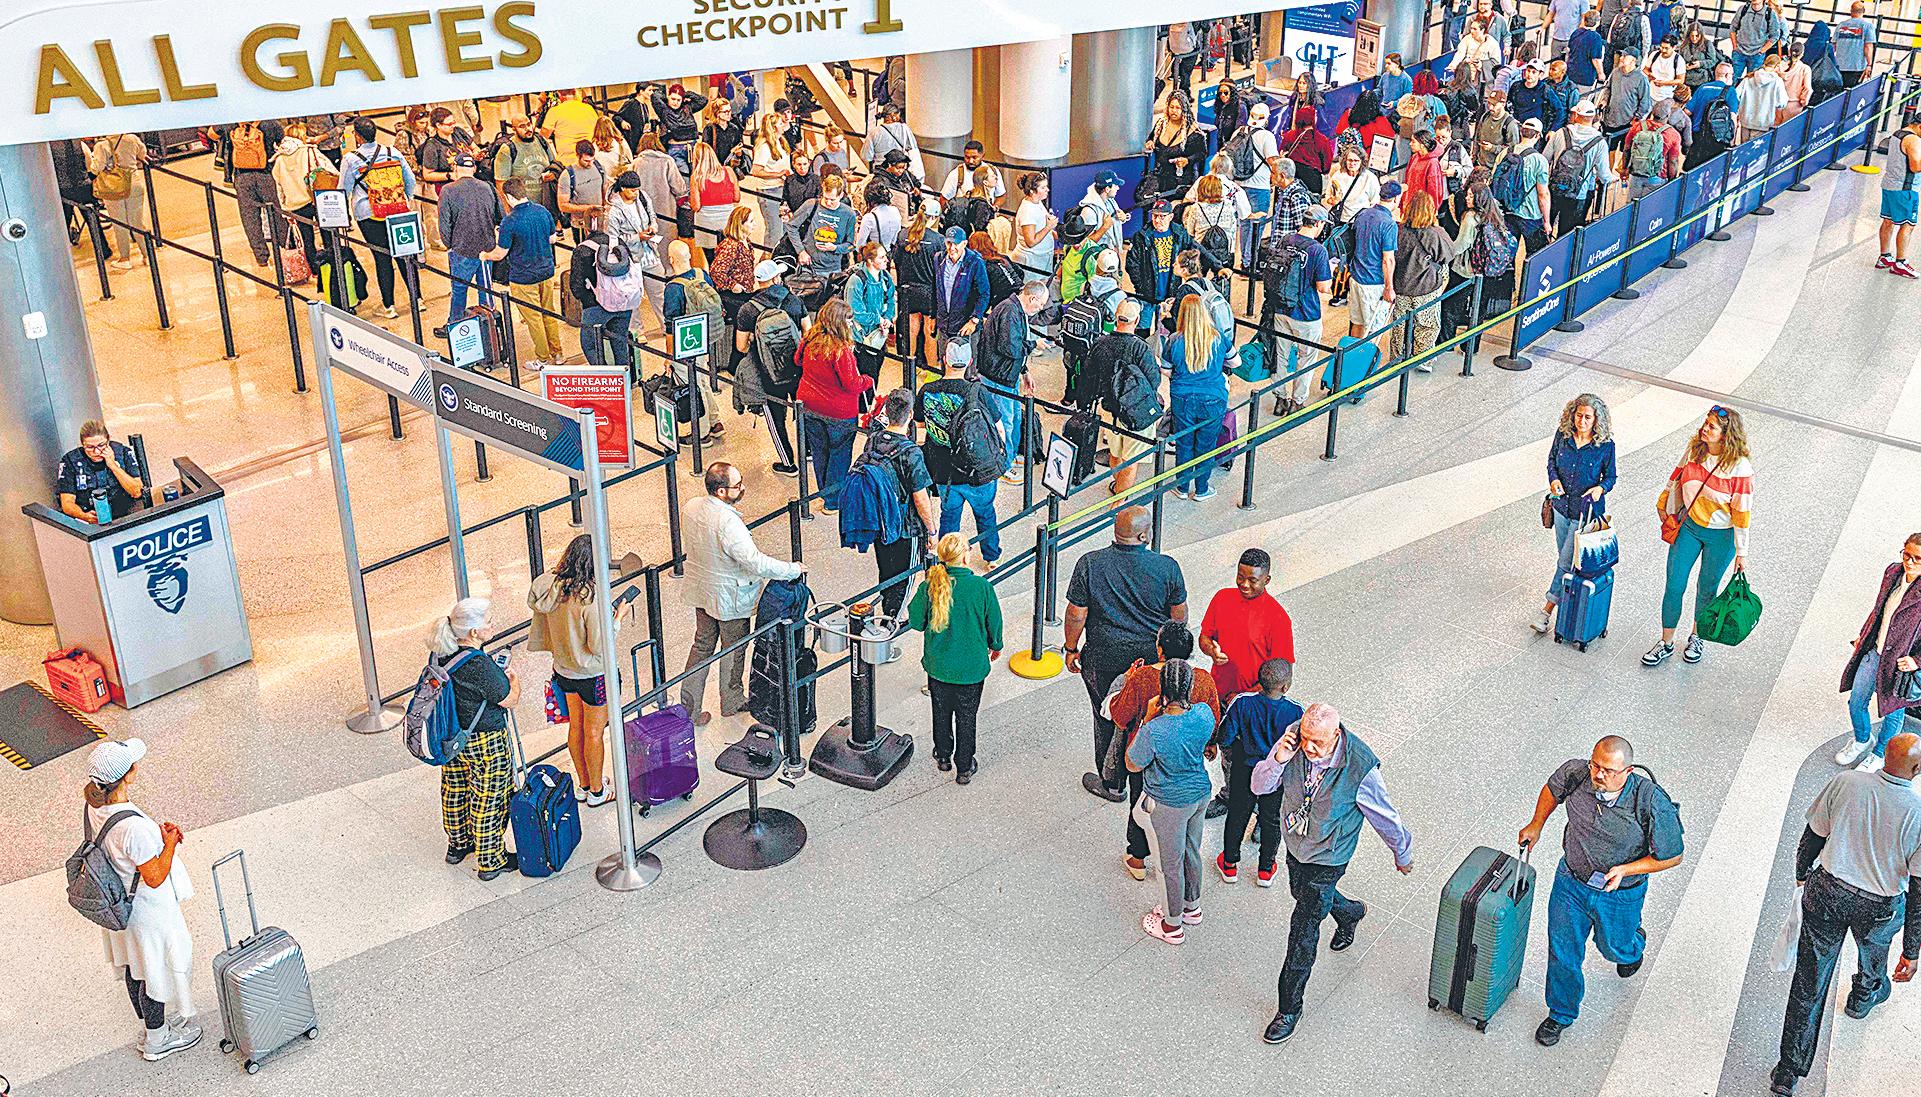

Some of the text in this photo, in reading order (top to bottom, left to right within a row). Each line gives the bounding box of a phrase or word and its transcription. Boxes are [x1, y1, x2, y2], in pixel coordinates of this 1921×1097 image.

[637, 7, 848, 48] CHECKPOINT
[34, 1, 543, 115] ALL GATES
[1586, 238, 1621, 268] AI-Powered
[1521, 295, 1561, 329] SentinelOne
[348, 338, 410, 377] Wheelchair Access
[552, 377, 624, 387] NO FIREARMS
[463, 397, 548, 441] Standard Screening
[122, 521, 203, 567] POLICE
